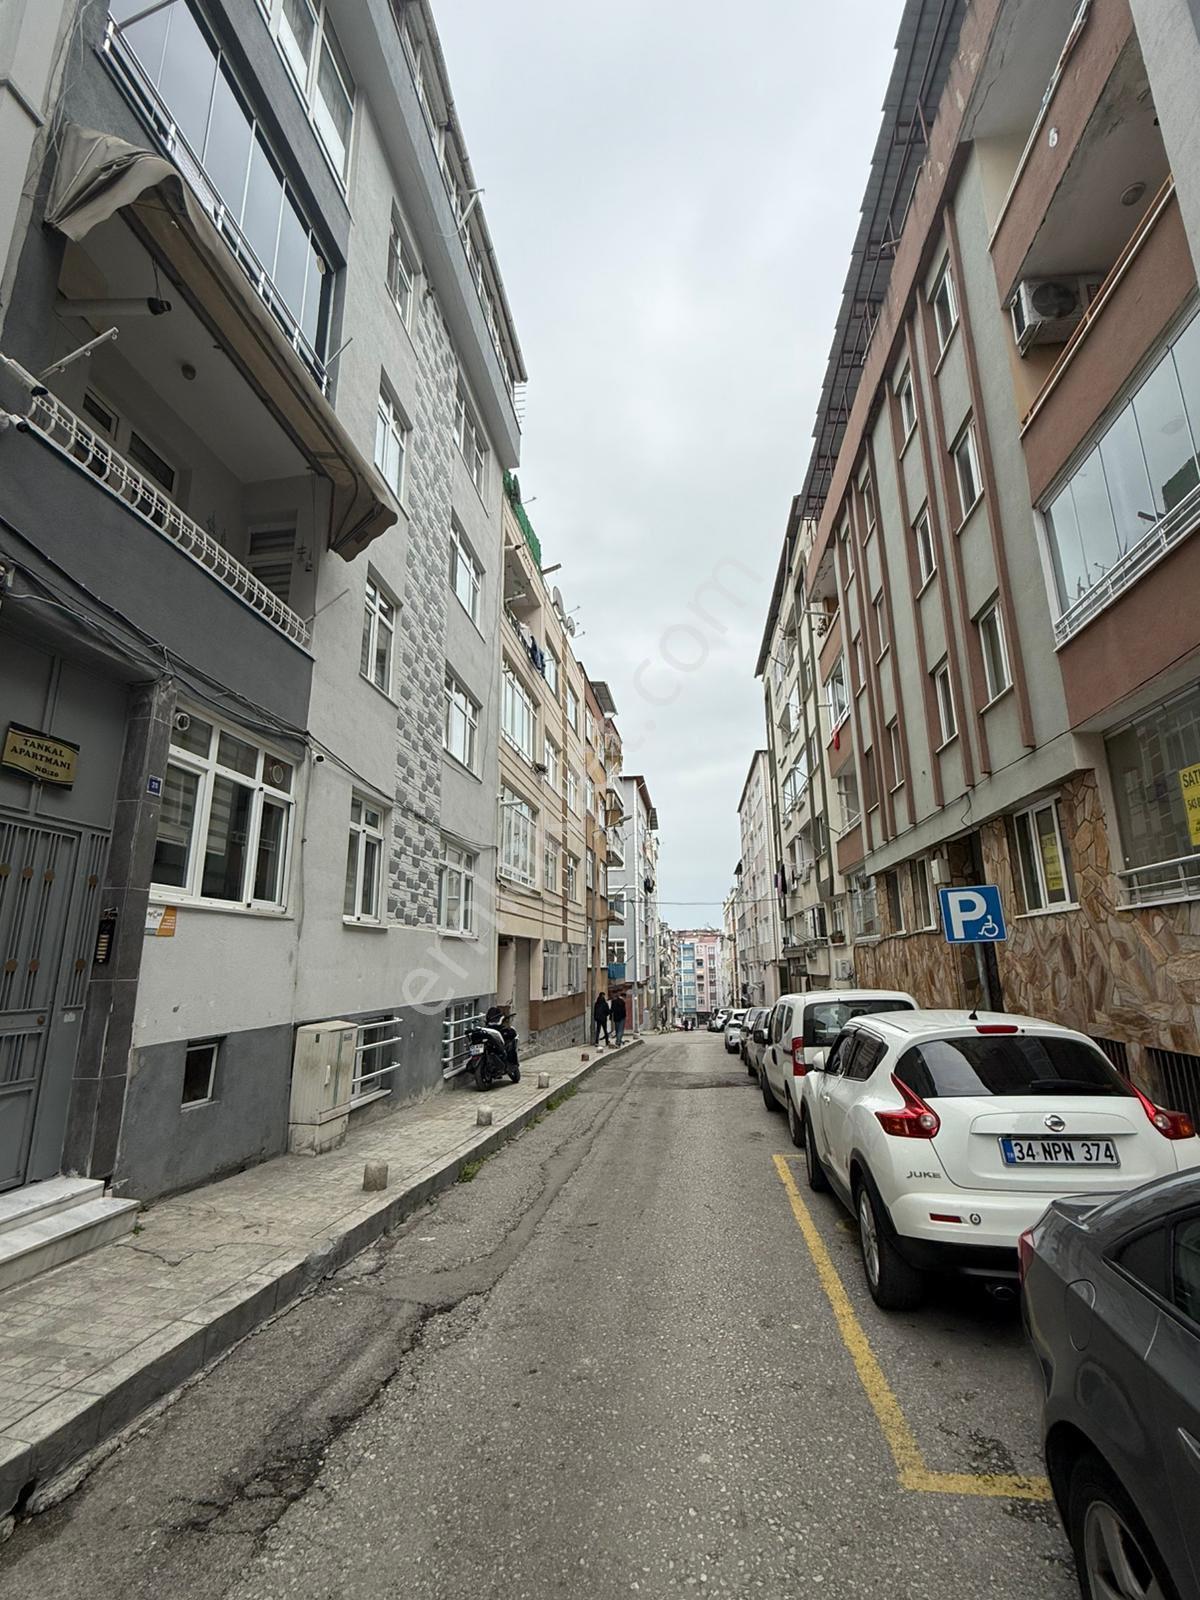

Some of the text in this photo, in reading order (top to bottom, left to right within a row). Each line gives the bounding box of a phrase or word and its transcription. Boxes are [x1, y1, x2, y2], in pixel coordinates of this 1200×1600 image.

[10, 745, 71, 770] APARTMANI
[23, 738, 65, 758] TANKAL
[947, 890, 987, 939] P
[1014, 1142, 1036, 1161] 34
[1041, 1142, 1075, 1161] NPN
[1081, 1143, 1114, 1162] 374
[906, 1170, 942, 1179] JUKE
